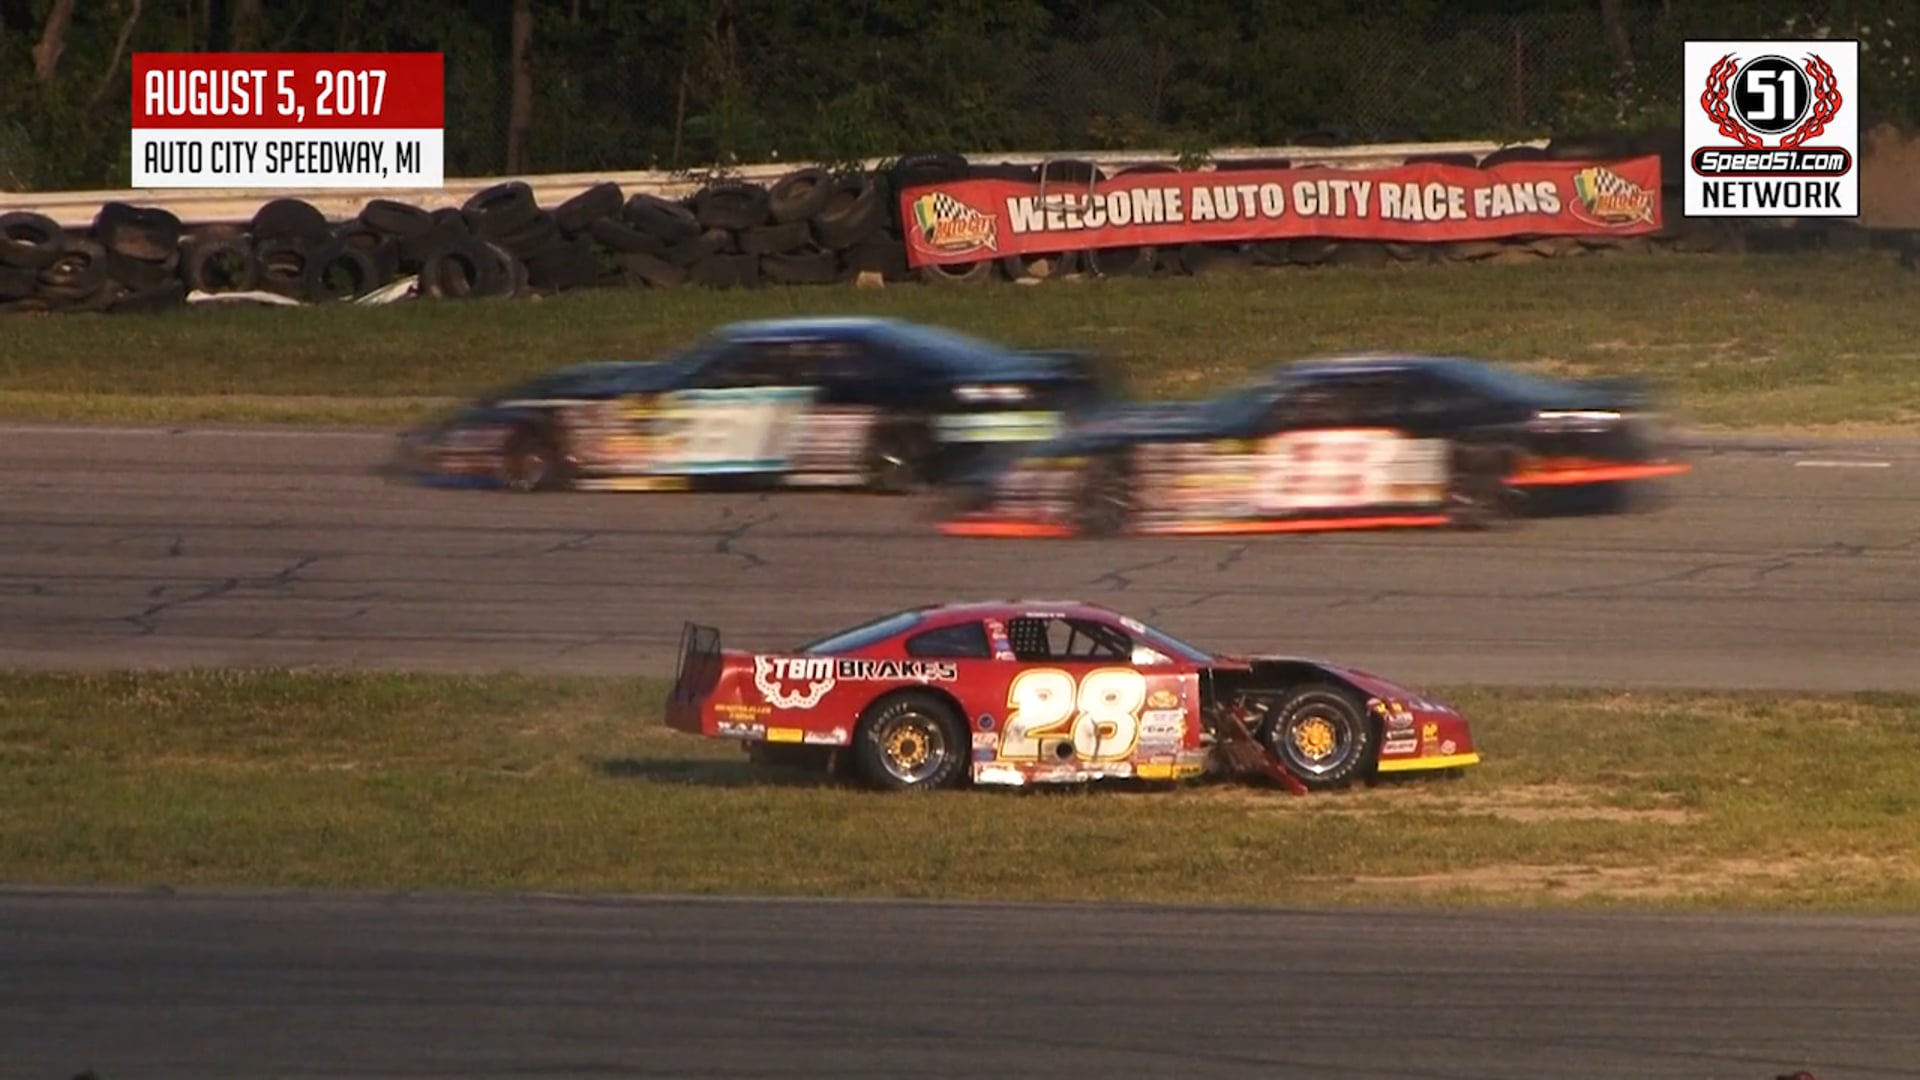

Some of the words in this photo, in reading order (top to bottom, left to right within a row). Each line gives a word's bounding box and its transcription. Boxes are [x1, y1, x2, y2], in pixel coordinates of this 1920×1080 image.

[1006, 188, 1184, 233] WELCOME
[1191, 183, 1286, 220] AUTO
[1293, 180, 1372, 217] CITY
[1379, 183, 1467, 221] RACE
[1474, 182, 1562, 218] FANS
[773, 659, 834, 680] TBM
[836, 659, 957, 682] BRAKES
[997, 667, 1147, 762] 28
